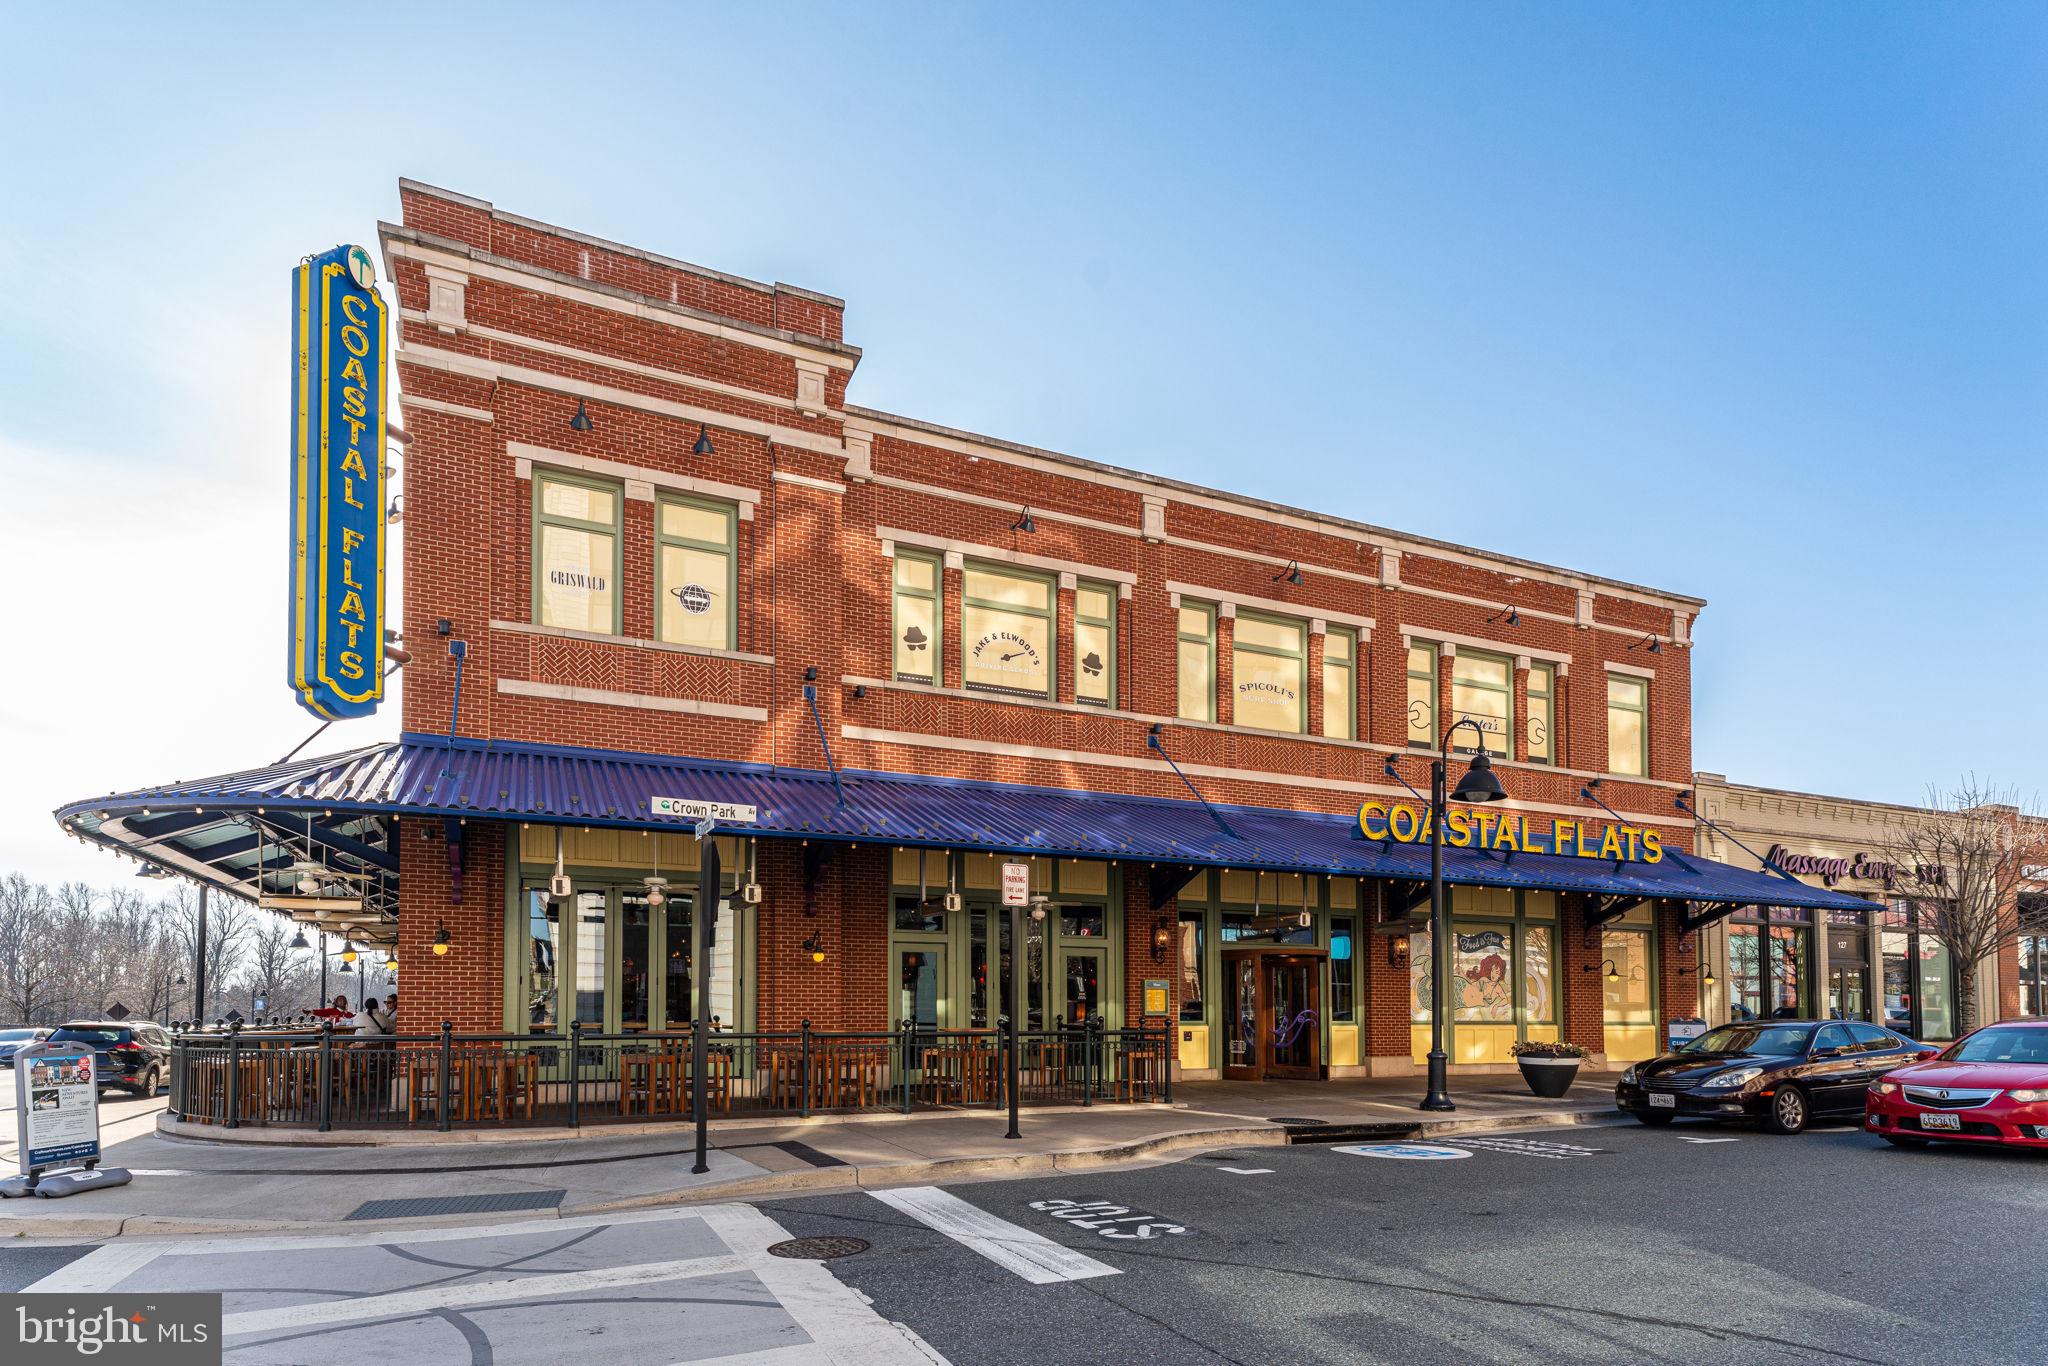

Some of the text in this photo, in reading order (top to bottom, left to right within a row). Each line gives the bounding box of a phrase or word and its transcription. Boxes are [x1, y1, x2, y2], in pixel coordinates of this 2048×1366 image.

[338, 294, 370, 681] COASTAL FLATS
[550, 570, 606, 591] GRISWALD
[972, 631, 1041, 666] JAKE & ELWOOD'S
[1238, 682, 1295, 700] SPICOLI'S
[672, 800, 756, 819] Crown Park Av
[1551, 819, 1663, 865] FLATS
[1011, 867, 1021, 876] NO
[1760, 843, 1851, 887] Massage
[1854, 851, 1897, 889] Envy
[1005, 875, 1026, 884] PARKING
[1459, 936, 1480, 951] Food
[1837, 940, 1847, 949] 127
[1028, 1199, 1186, 1240] STOP
